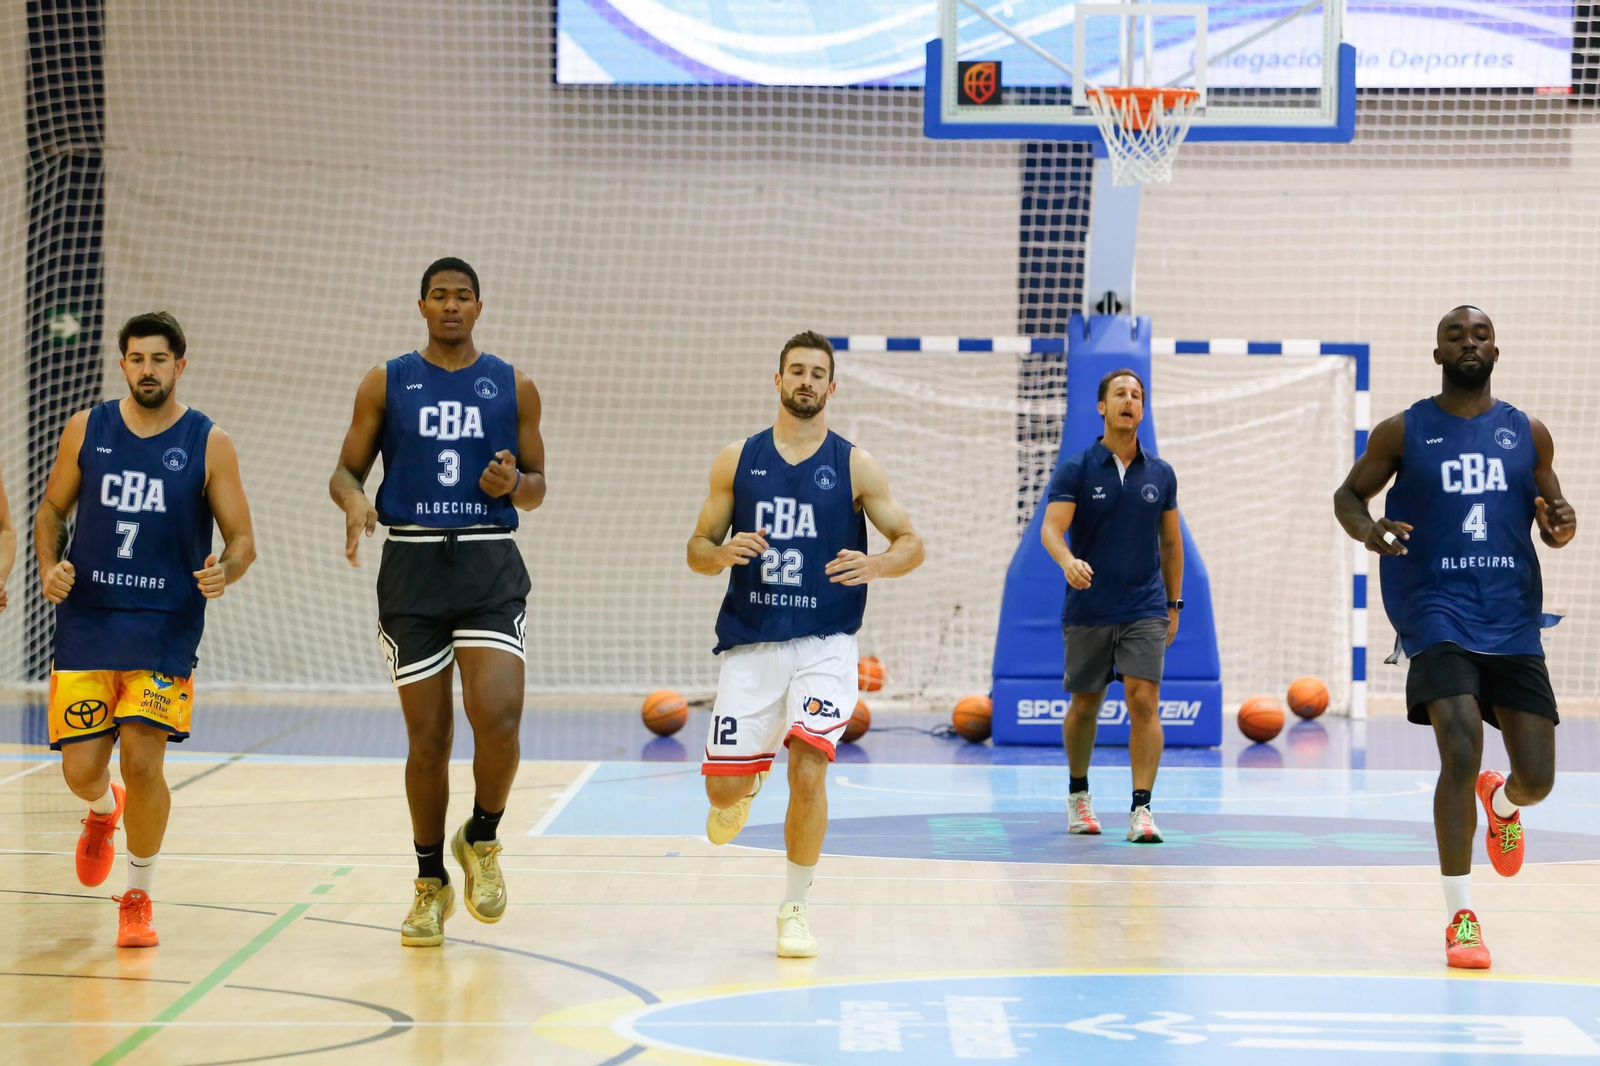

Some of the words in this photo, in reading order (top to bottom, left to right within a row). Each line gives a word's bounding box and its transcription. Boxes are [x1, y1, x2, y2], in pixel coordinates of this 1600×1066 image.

[1189, 50, 1323, 75] legació
[1389, 50, 1514, 73] Deportes
[419, 400, 484, 441] CBA
[437, 449, 460, 486] 3
[1441, 453, 1508, 495] CBA
[101, 470, 167, 513] CBA
[416, 502, 488, 515] ALGECIRAS
[755, 496, 817, 539] CBA
[1462, 503, 1487, 541] 4
[115, 521, 139, 558] 7
[92, 570, 165, 588] ALGECIRAS
[760, 547, 803, 586] 22
[1442, 556, 1515, 569] ALGECIRAS
[750, 591, 817, 608] ALGECIRAS
[143, 689, 171, 705] Poema
[713, 715, 737, 745] 12
